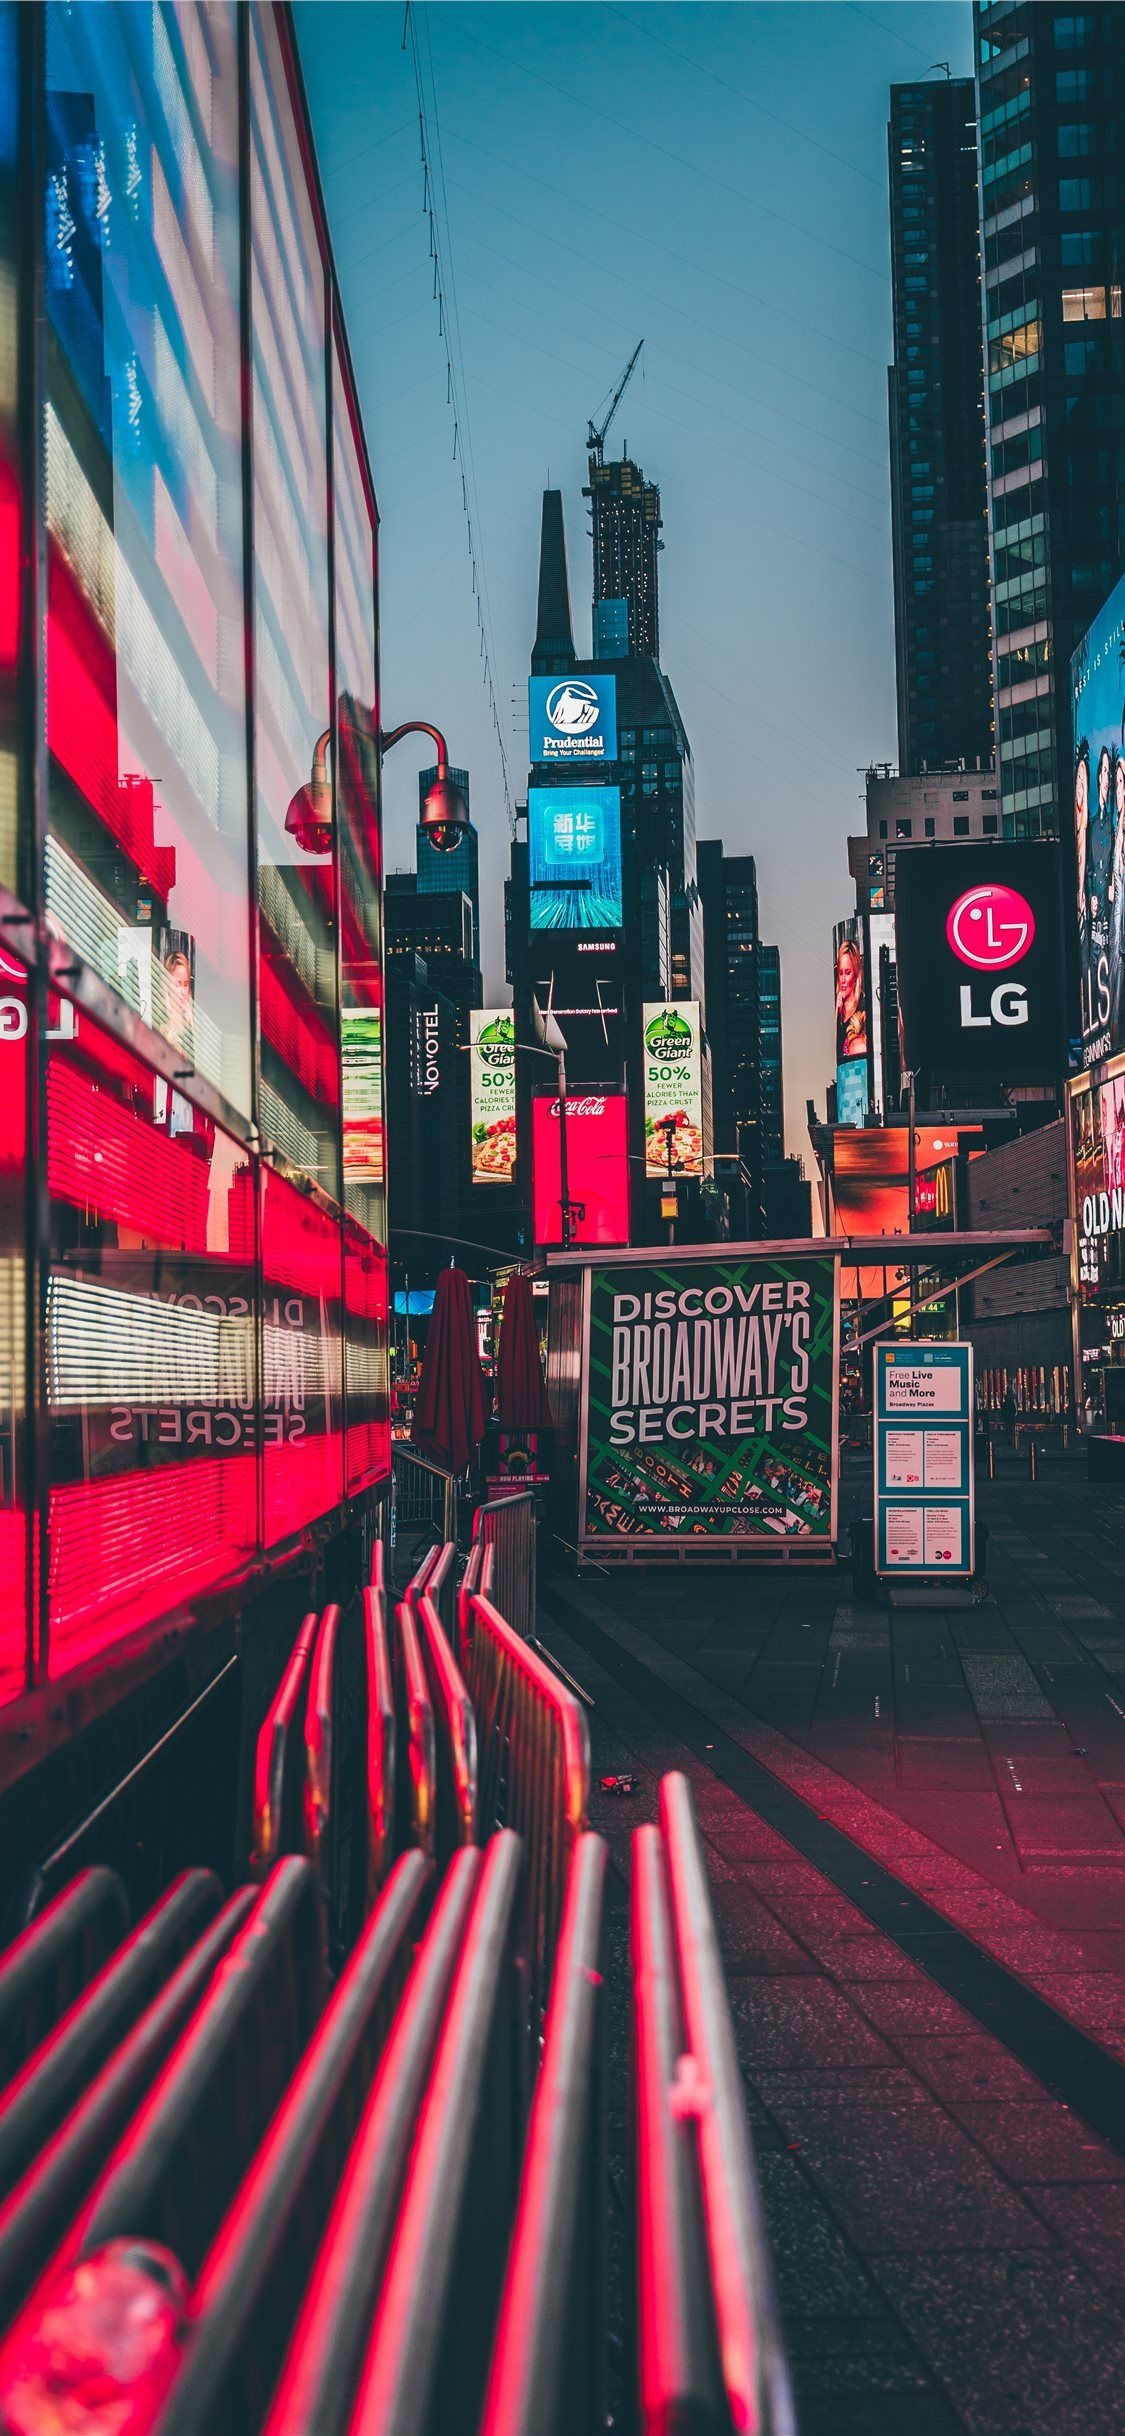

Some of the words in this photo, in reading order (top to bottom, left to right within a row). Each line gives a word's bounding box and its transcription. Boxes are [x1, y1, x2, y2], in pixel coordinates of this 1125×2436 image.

[543, 736, 604, 749] Prudential
[543, 749, 559, 757] Bring
[577, 943, 616, 952] SAMSUNG
[960, 982, 1029, 1027] LG
[575, 1008, 591, 1016] Galaxy
[650, 1036, 690, 1048] Green
[424, 1003, 439, 1095] NOVOTEL
[655, 1047, 692, 1059] Giant
[648, 1066, 691, 1081] 50%
[1083, 1191, 1110, 1237] OLD
[613, 1280, 810, 1323] DISCOVER
[928, 1303, 938, 1311] 44
[611, 1311, 810, 1408] BROADWAY'S
[889, 1371, 910, 1379] Free
[912, 1371, 933, 1379] Live
[889, 1380, 920, 1388] Music
[889, 1389, 907, 1397] and
[909, 1389, 936, 1397] More
[609, 1396, 808, 1445] SECRETS
[638, 1504, 783, 1515] WWW.BROADWAYUPCLOSE.COM
